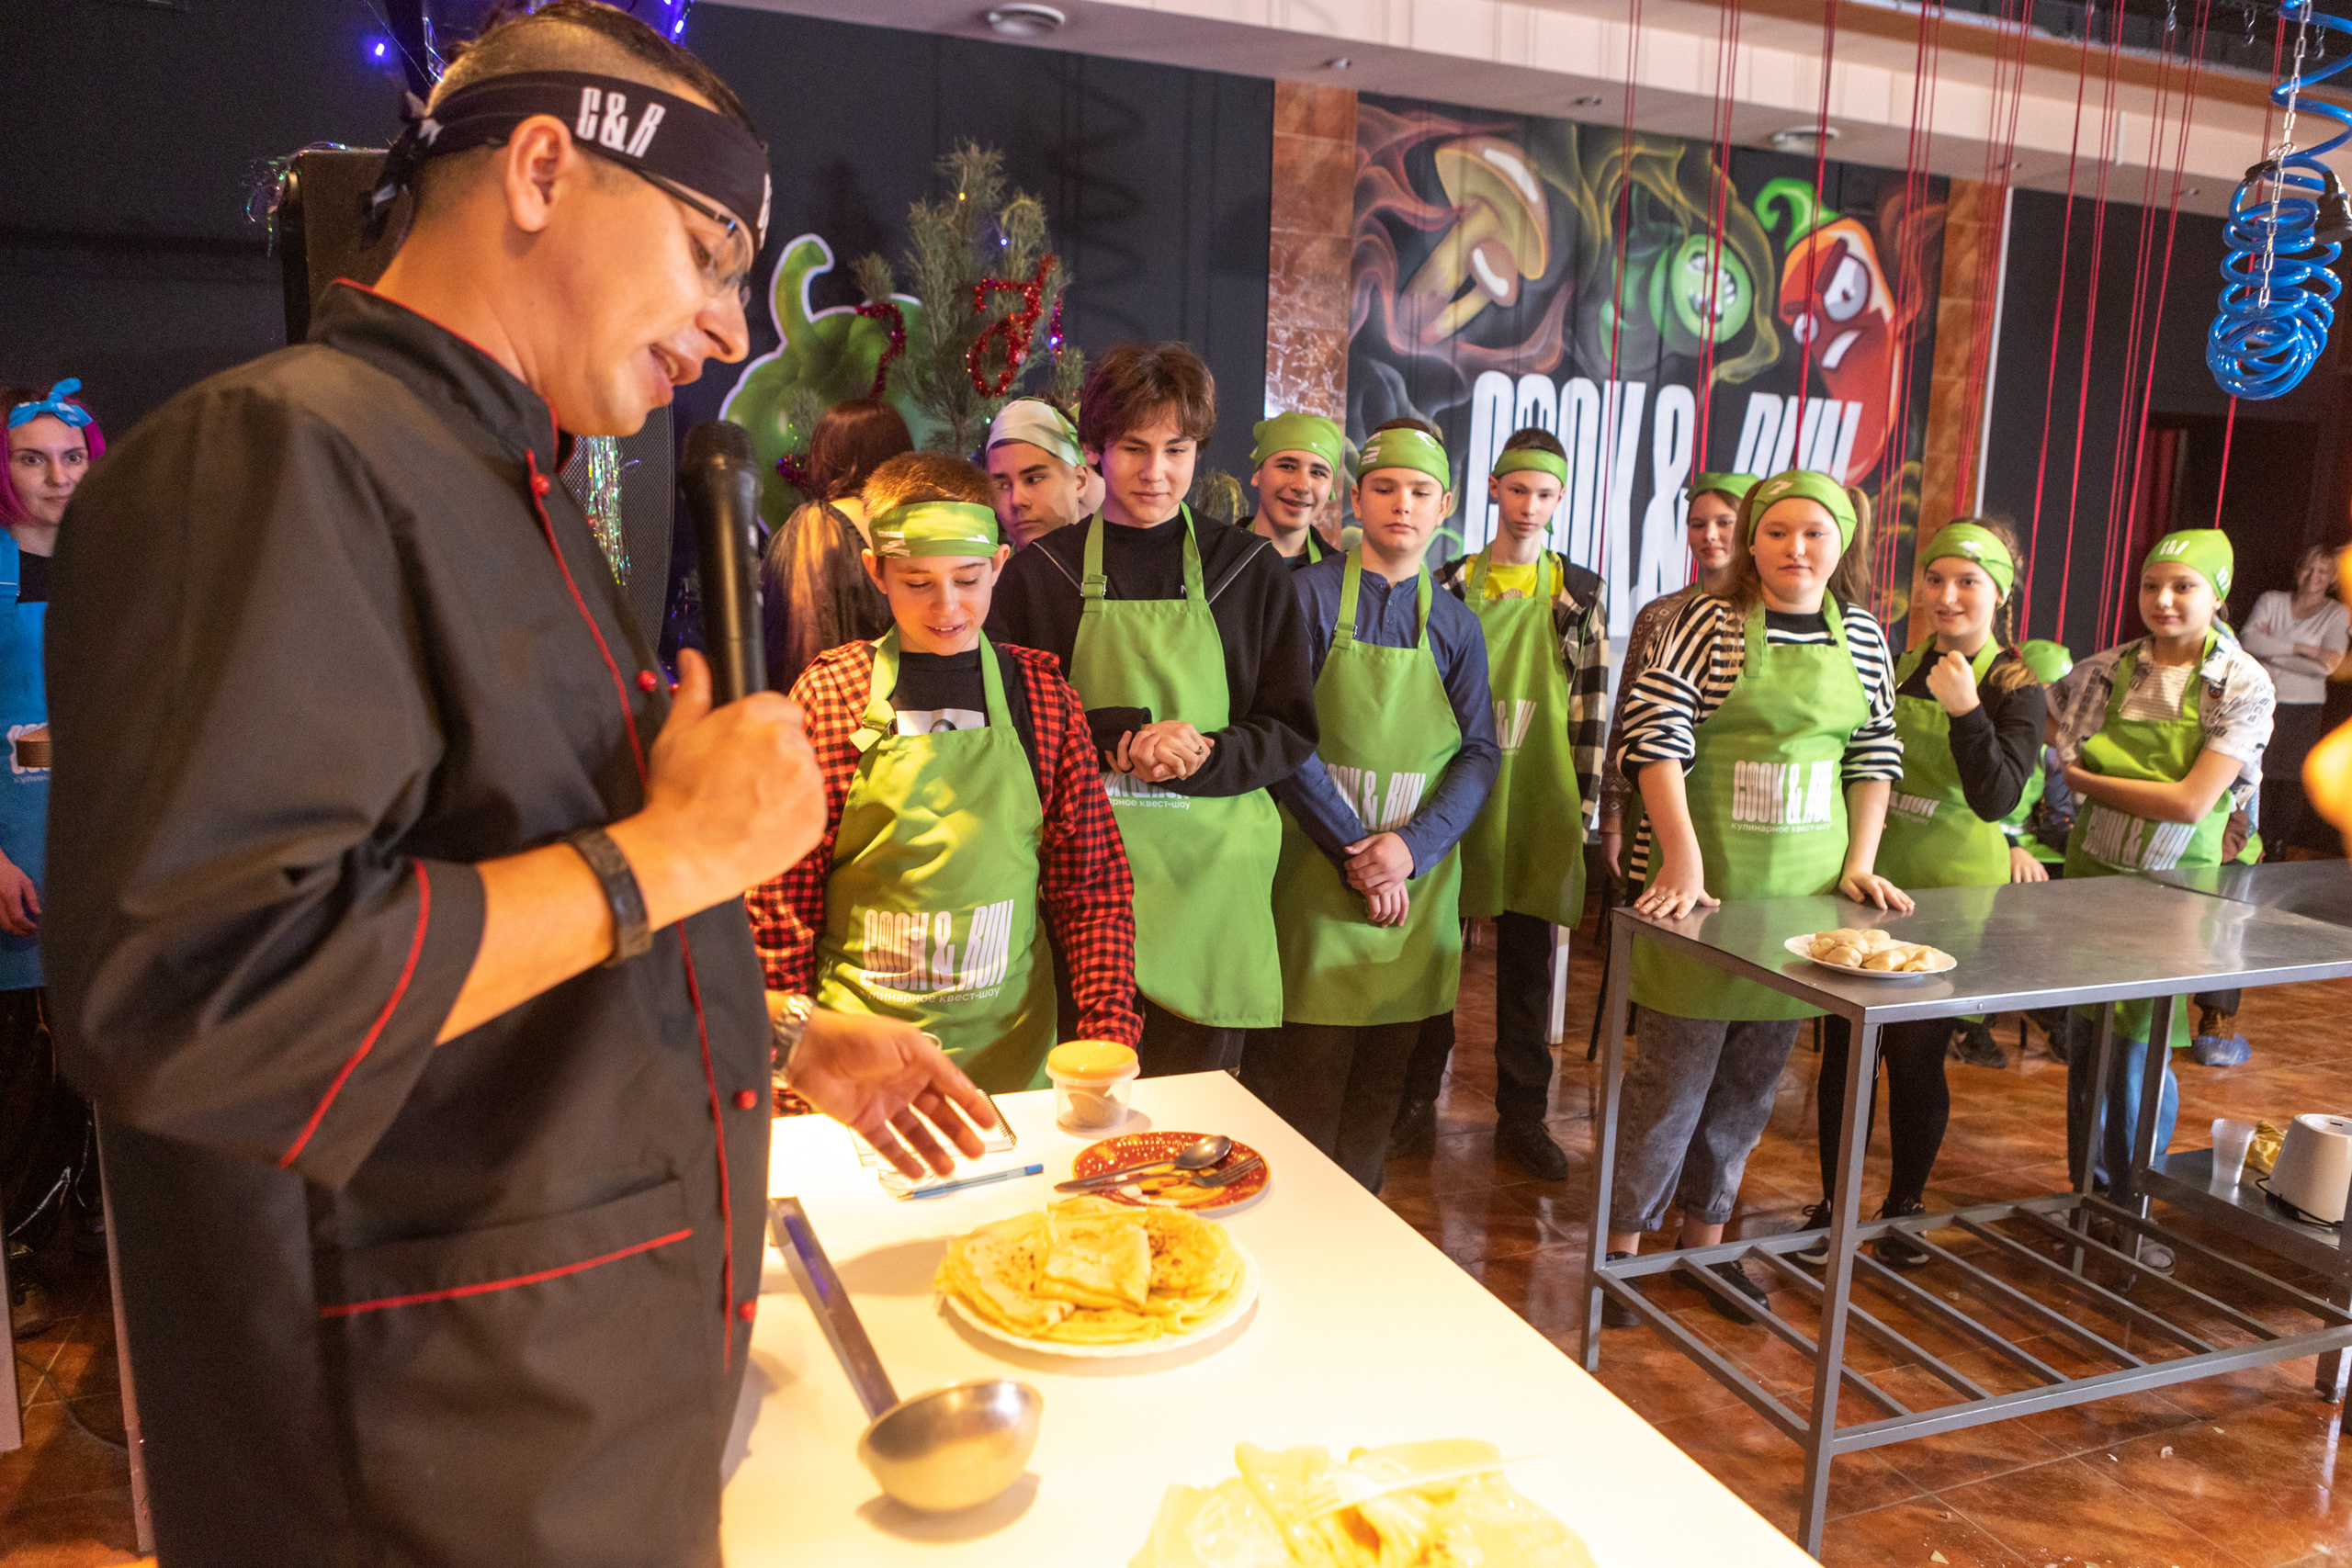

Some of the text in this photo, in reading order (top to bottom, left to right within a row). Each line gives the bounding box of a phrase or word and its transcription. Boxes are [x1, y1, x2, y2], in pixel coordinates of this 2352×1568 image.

[575, 86, 666, 158] C&R
[1139, 800, 1191, 810] квест-шоу
[1732, 760, 1786, 824] COOK
[859, 898, 1014, 992] COOK & RUN
[939, 987, 1001, 1003] квест-шоу
